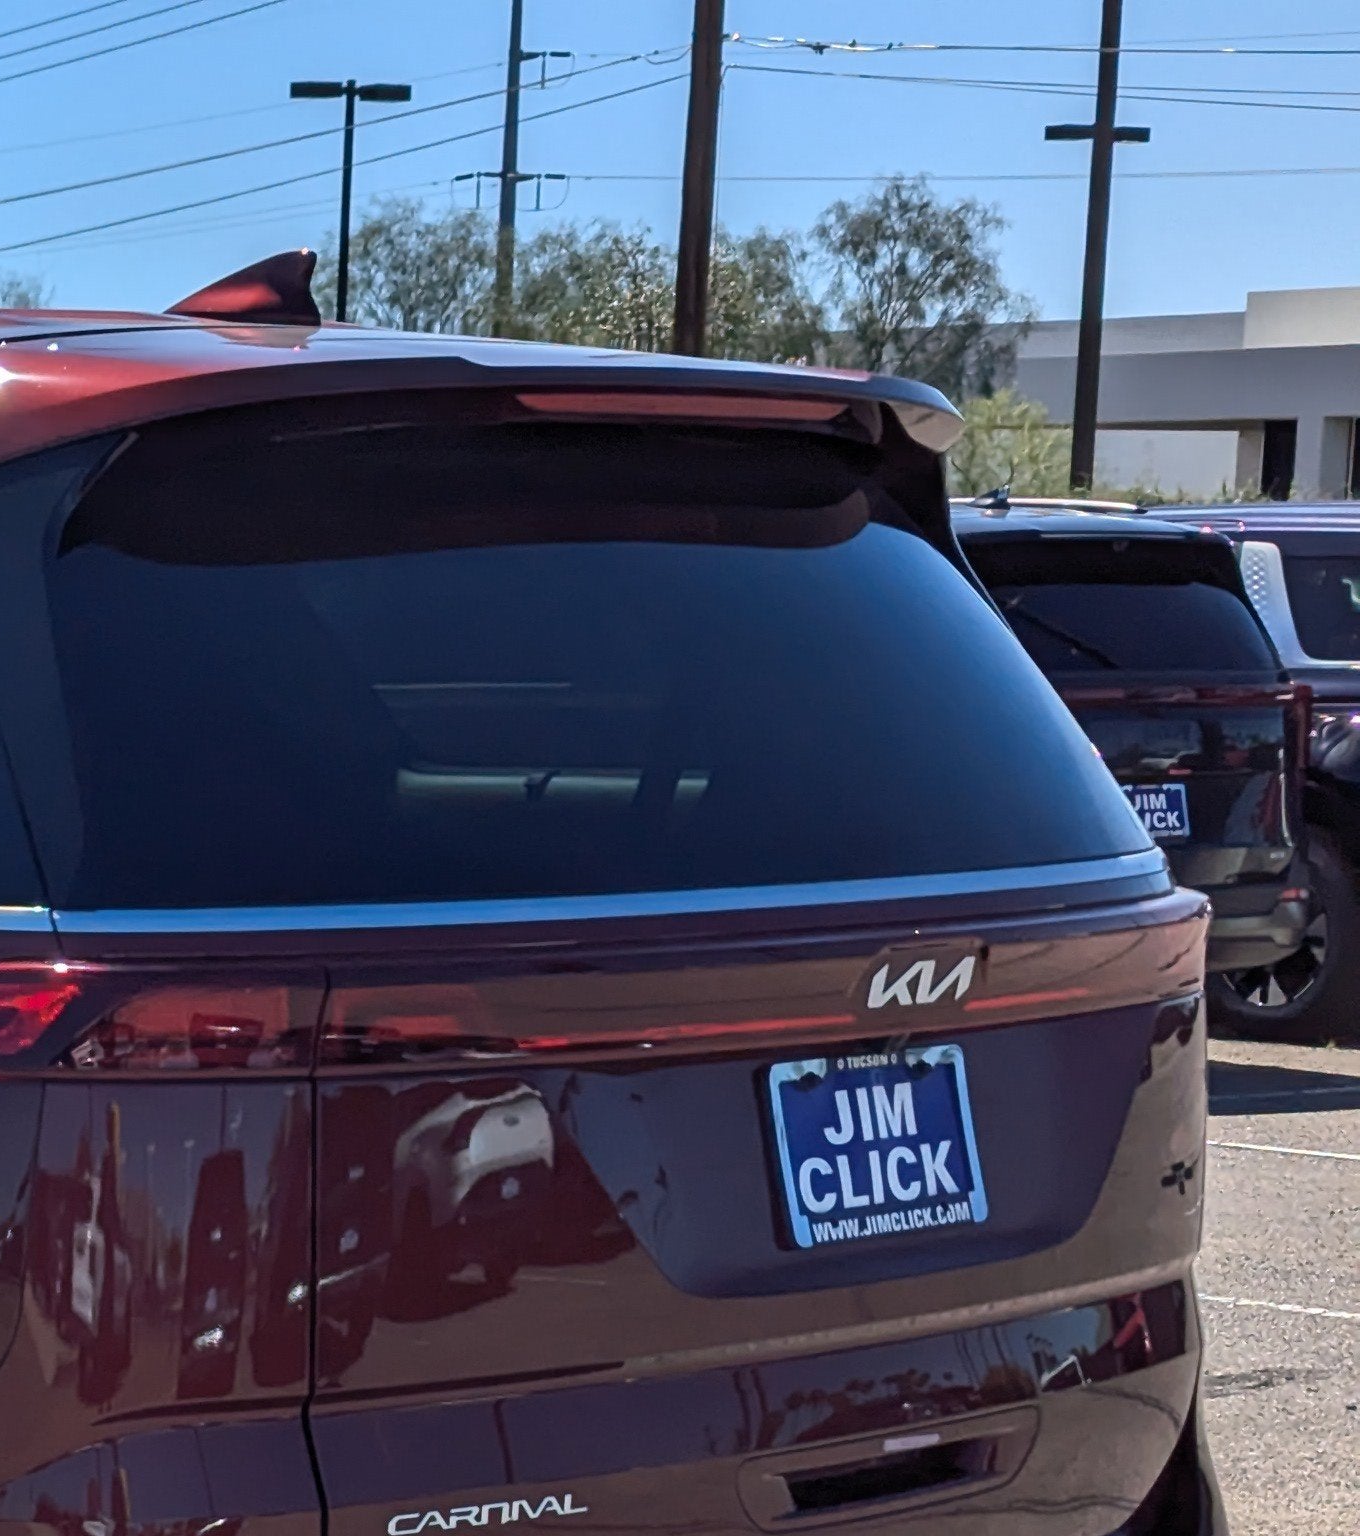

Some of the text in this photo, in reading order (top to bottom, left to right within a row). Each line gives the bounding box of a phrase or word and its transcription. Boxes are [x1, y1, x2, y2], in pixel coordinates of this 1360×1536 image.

[1144, 811, 1181, 832] ICK
[867, 955, 976, 1009] KIA
[846, 1054, 888, 1069] TUCSON
[823, 1082, 918, 1145] JIM
[799, 1140, 960, 1214] CLICK
[812, 1201, 971, 1243] WWW.JIMCLICK.COM
[387, 1493, 588, 1536] CARNIVAL
